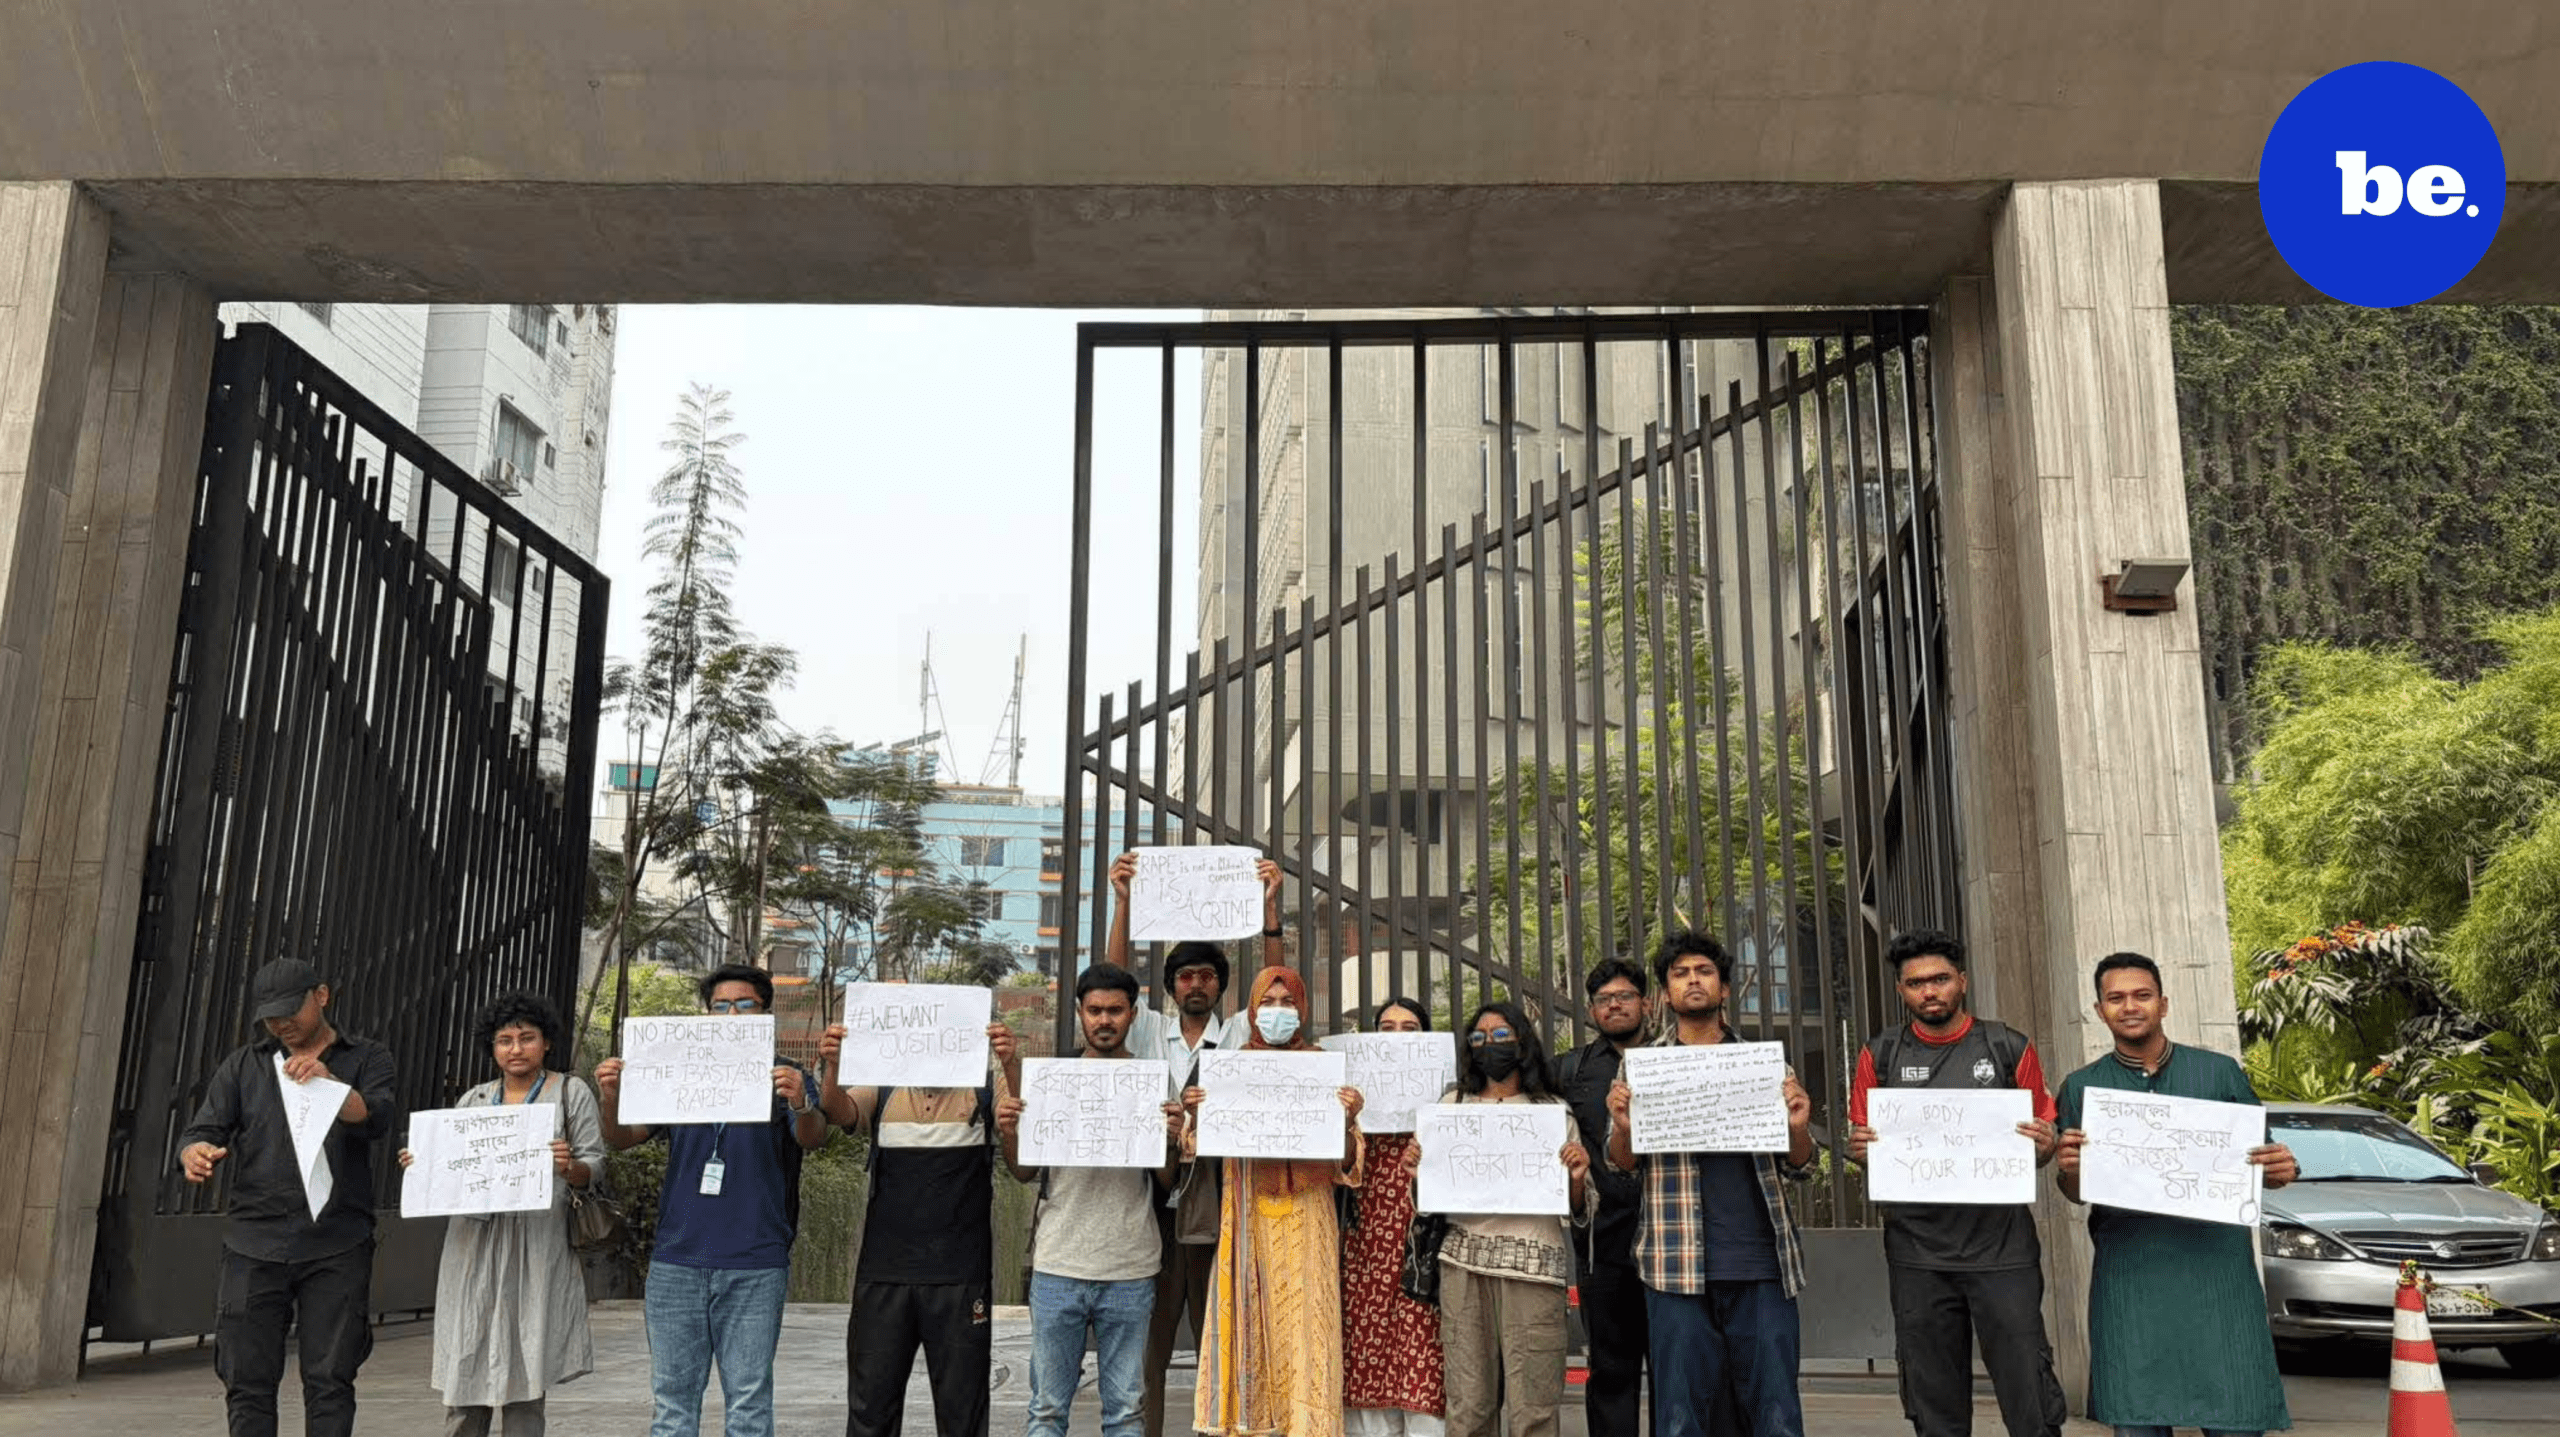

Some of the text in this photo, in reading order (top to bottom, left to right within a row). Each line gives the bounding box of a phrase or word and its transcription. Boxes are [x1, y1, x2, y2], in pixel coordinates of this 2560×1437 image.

[1141, 854, 1176, 875] RAPE
[1180, 861, 1189, 873] is
[1133, 878, 1147, 894] IT
[1200, 898, 1256, 929] CRIME
[634, 1022, 658, 1045] NO
[665, 1022, 723, 1043] POWER
[878, 1027, 973, 1059] JUSTICE
[687, 1046, 716, 1061] FOR
[1344, 1040, 1439, 1062] HANG THE
[635, 1064, 674, 1080] THE
[681, 1061, 767, 1085] BASTARD
[672, 1087, 739, 1112] RAPIST
[1877, 1101, 1964, 1126] MY BODY
[1905, 1134, 1977, 1151] IS NOT
[1894, 1157, 2030, 1185] YOUR POWER
